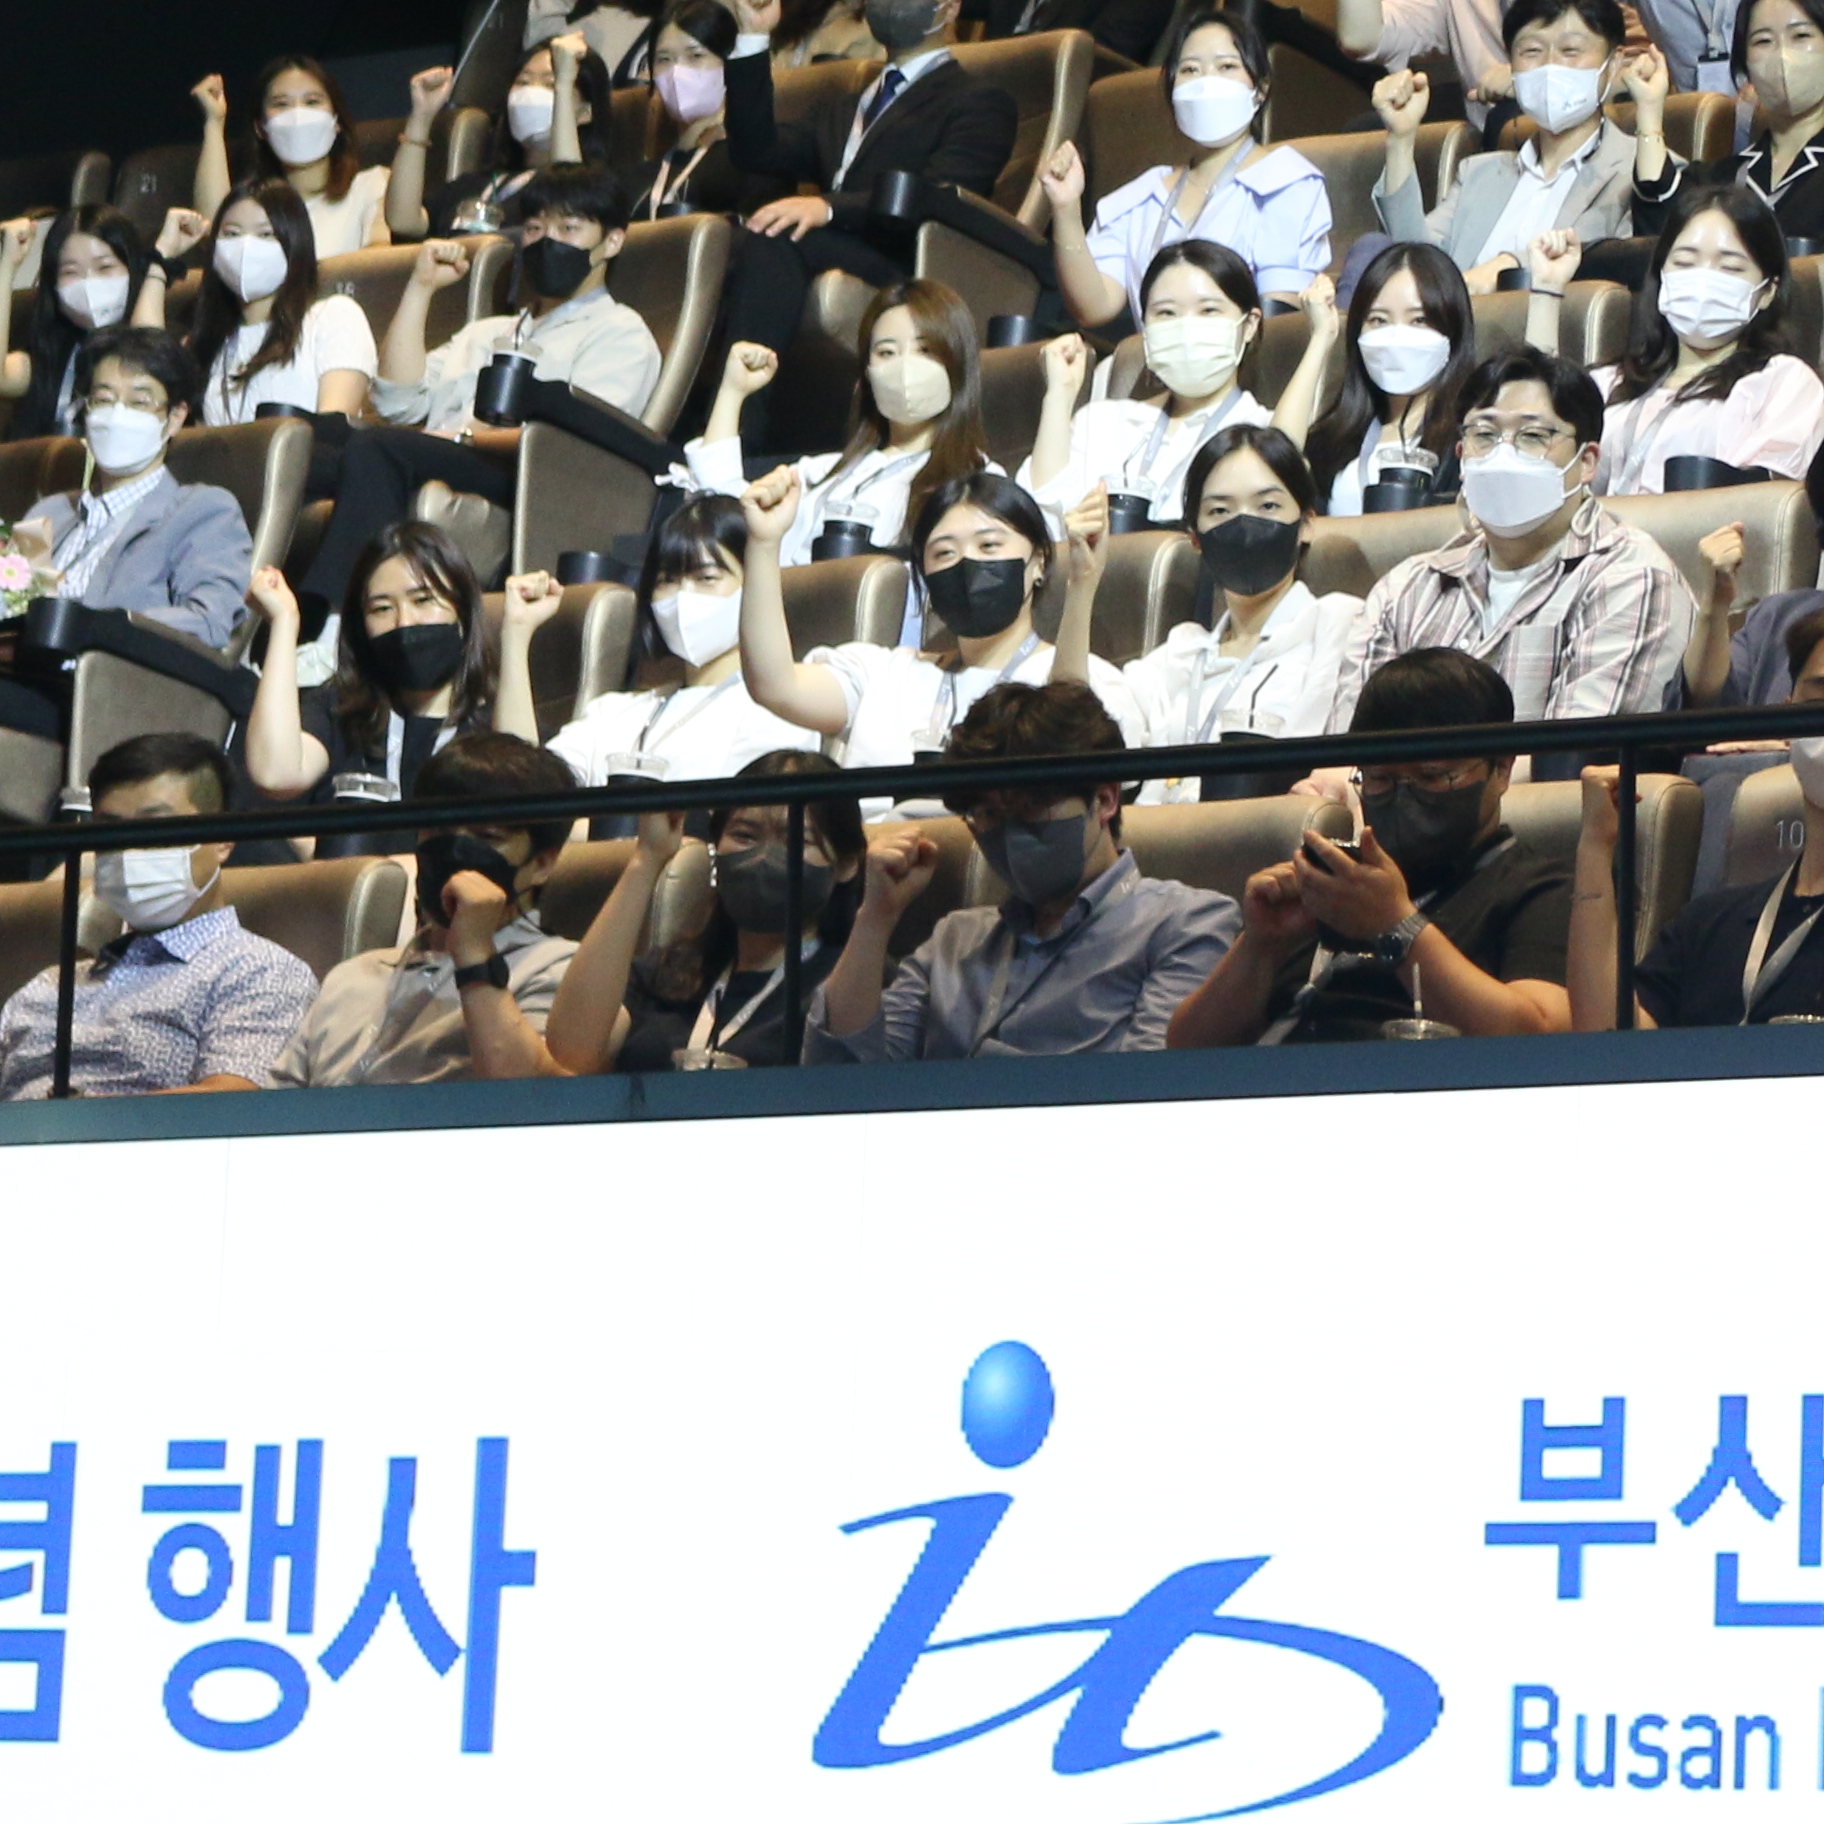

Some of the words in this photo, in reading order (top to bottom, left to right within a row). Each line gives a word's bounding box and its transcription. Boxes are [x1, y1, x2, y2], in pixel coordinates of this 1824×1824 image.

[139, 173, 158, 194] 21
[1775, 819, 1805, 850] 10
[141, 1436, 537, 1755] 행사
[1508, 1683, 1781, 1791] Busan
